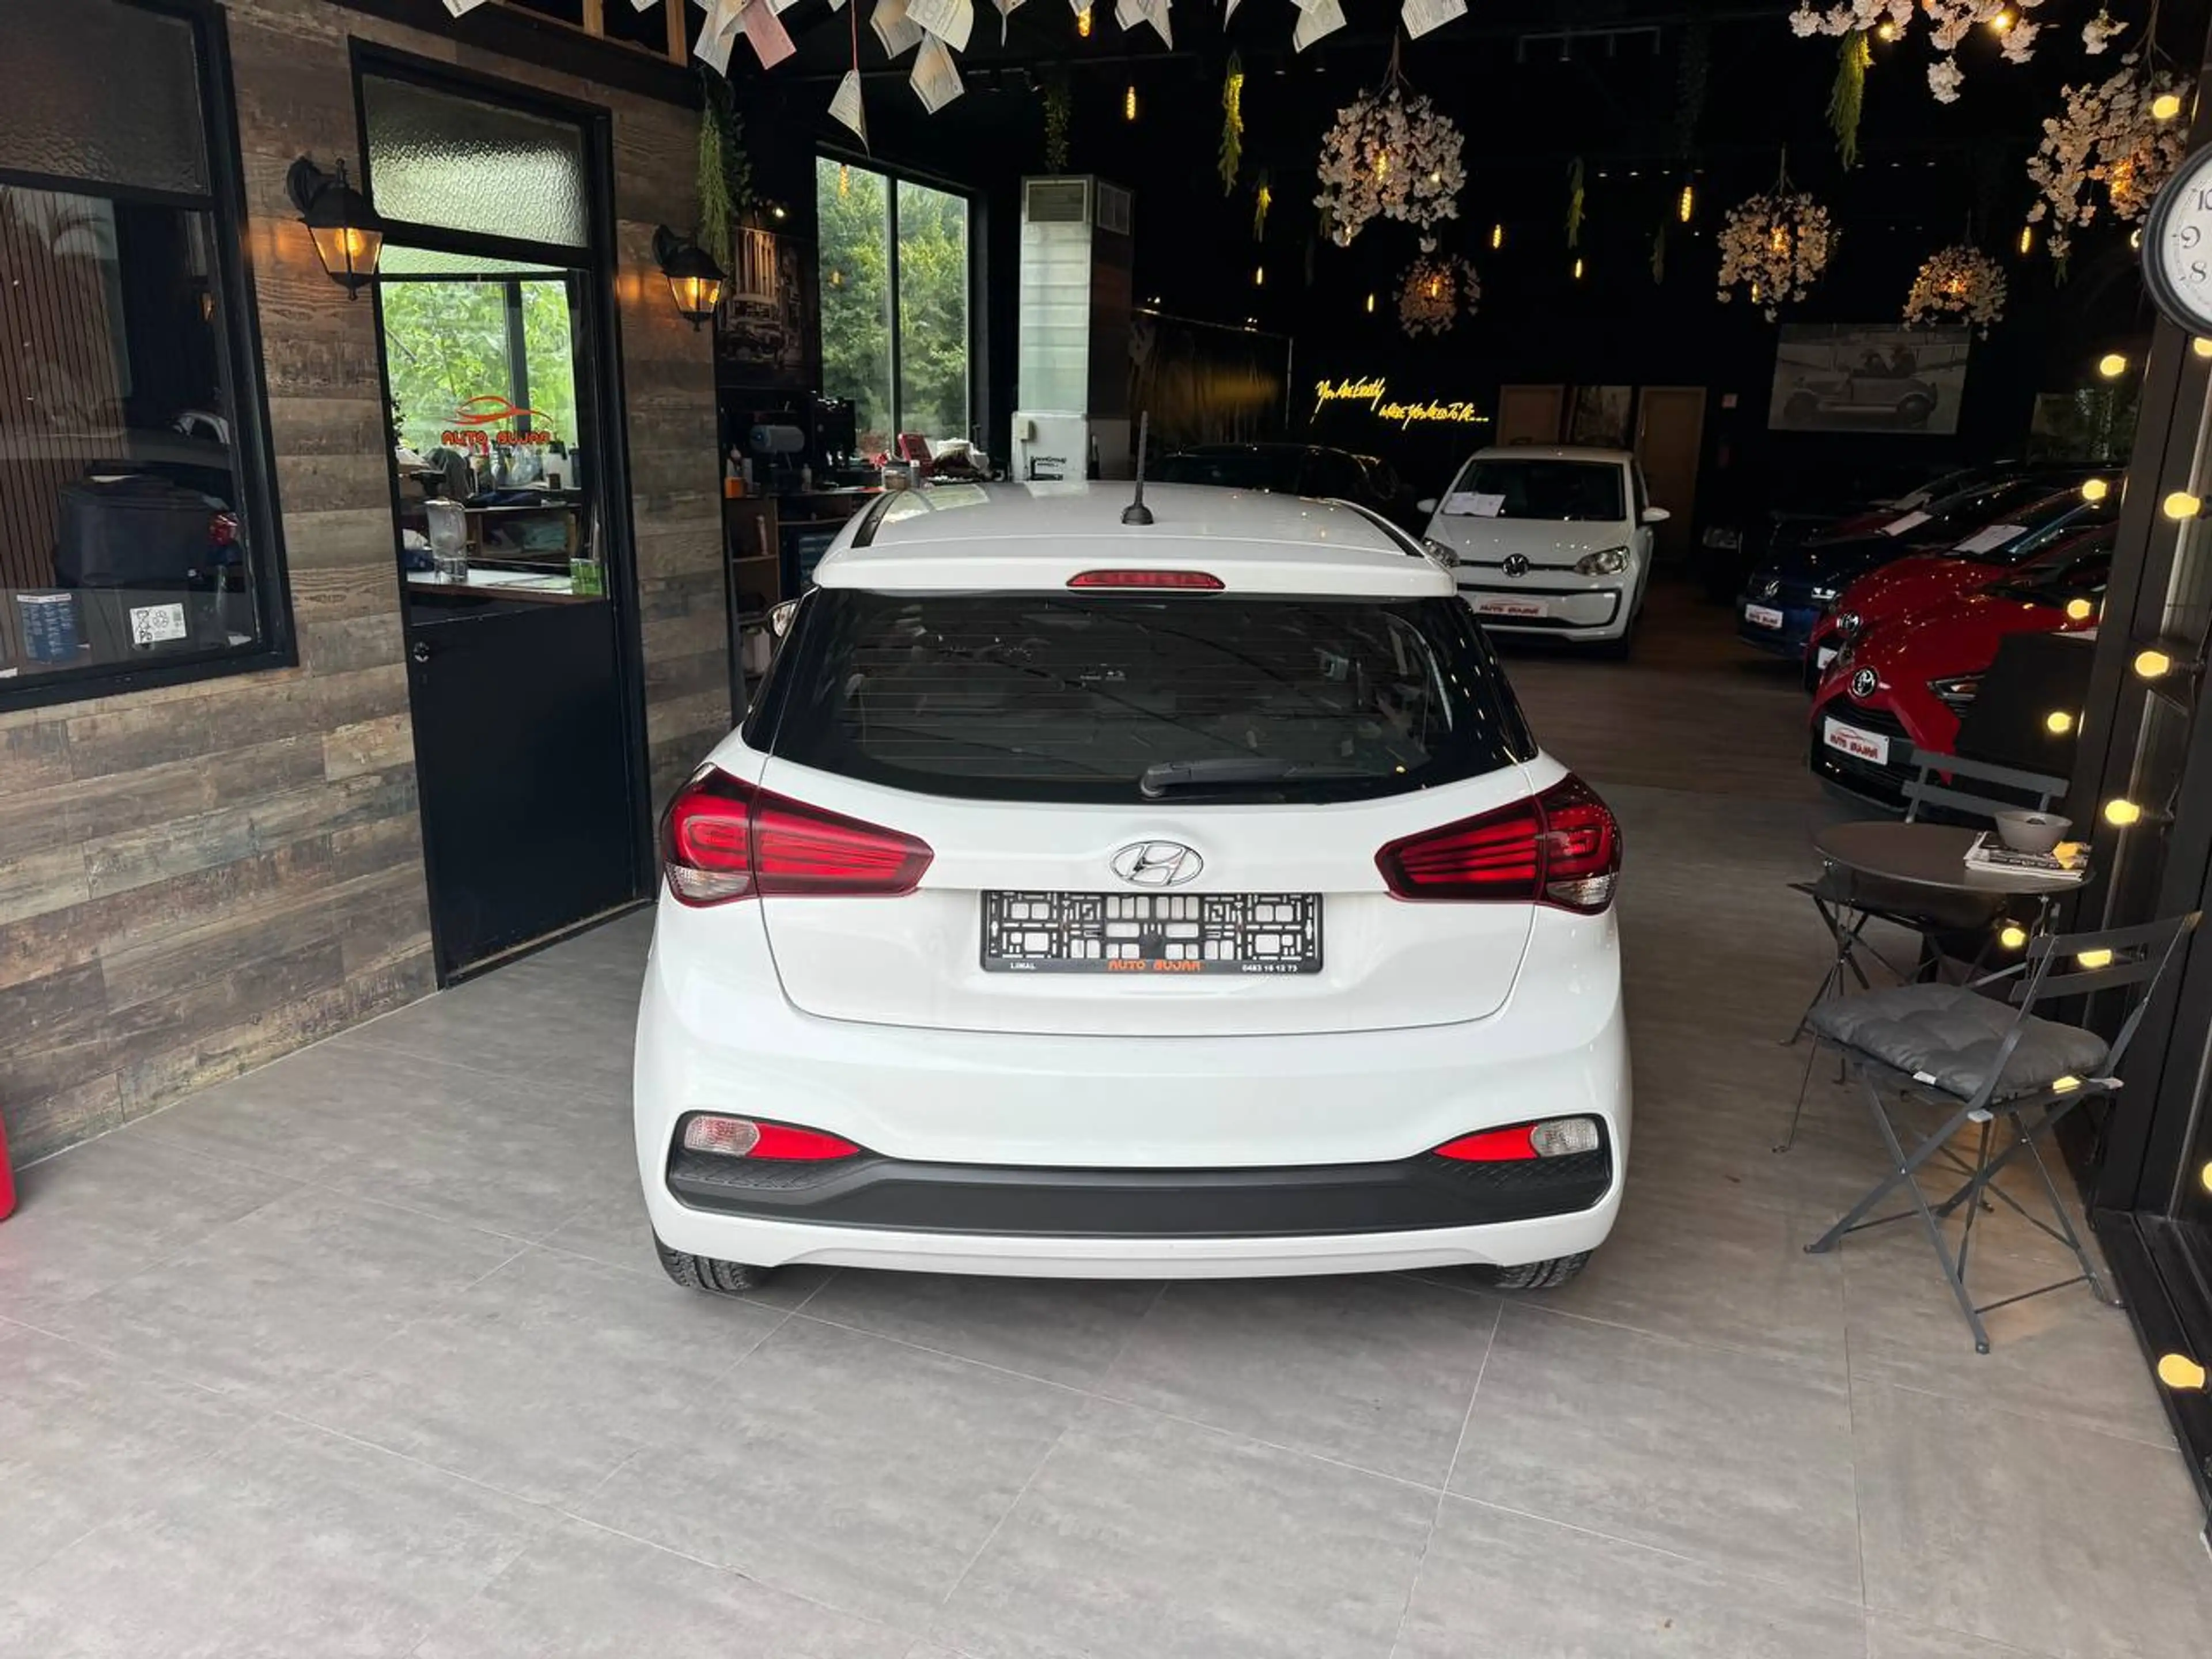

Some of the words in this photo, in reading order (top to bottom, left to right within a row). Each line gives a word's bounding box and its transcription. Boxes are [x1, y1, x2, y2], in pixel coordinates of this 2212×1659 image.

[2181, 226, 2200, 249] 9
[2190, 260, 2207, 284] 8
[441, 430, 488, 446] AUTO
[495, 430, 551, 446] BUJAR
[1108, 959, 1146, 971] AUTO
[1153, 959, 1202, 972] BUJAR
